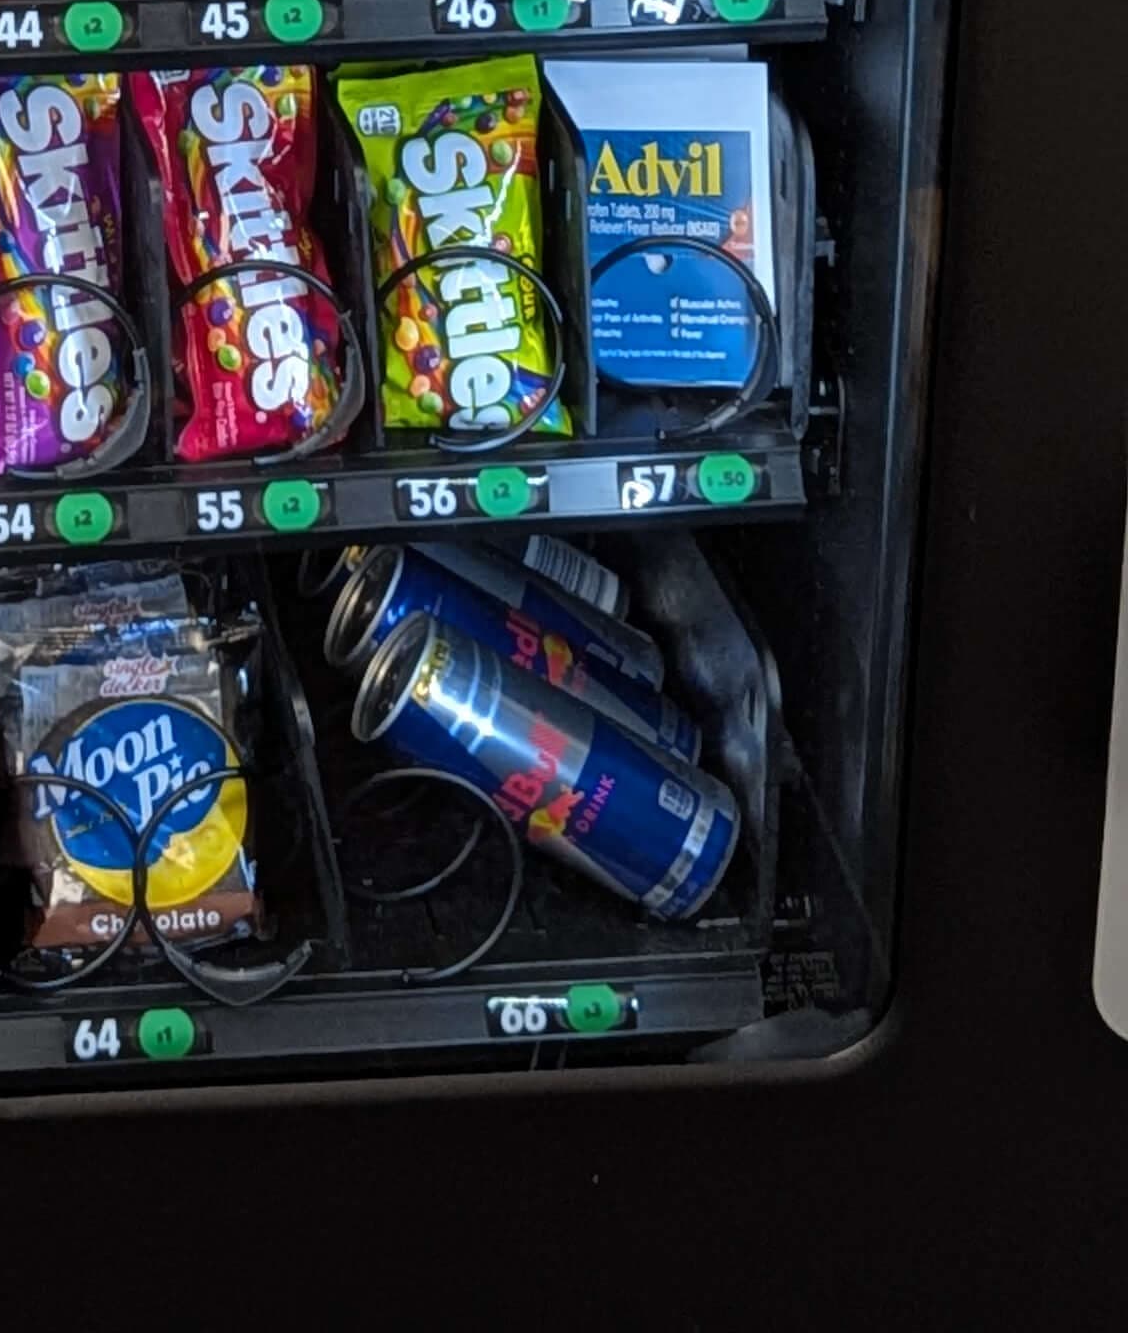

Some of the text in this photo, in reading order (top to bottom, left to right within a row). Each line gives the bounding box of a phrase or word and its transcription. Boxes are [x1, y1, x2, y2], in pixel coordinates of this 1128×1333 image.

[200, 2, 250, 38] 45
[283, 7, 303, 25] $2
[532, 0, 550, 17] $1
[83, 17, 104, 35] $2
[589, 139, 722, 197] Advil
[191, 83, 312, 413] Skittles
[402, 133, 521, 432] Skittles
[409, 483, 457, 516] 56
[492, 482, 511, 500] $2
[634, 465, 676, 503] 57
[74, 509, 94, 528] $2
[196, 491, 245, 529] 55
[282, 496, 301, 514] $2
[100, 674, 165, 696] decker
[31, 712, 176, 817] Moon
[574, 773, 616, 834] DRINK
[501, 1003, 548, 1033] 66
[74, 1020, 121, 1059] 64
[156, 1026, 173, 1044] $1
